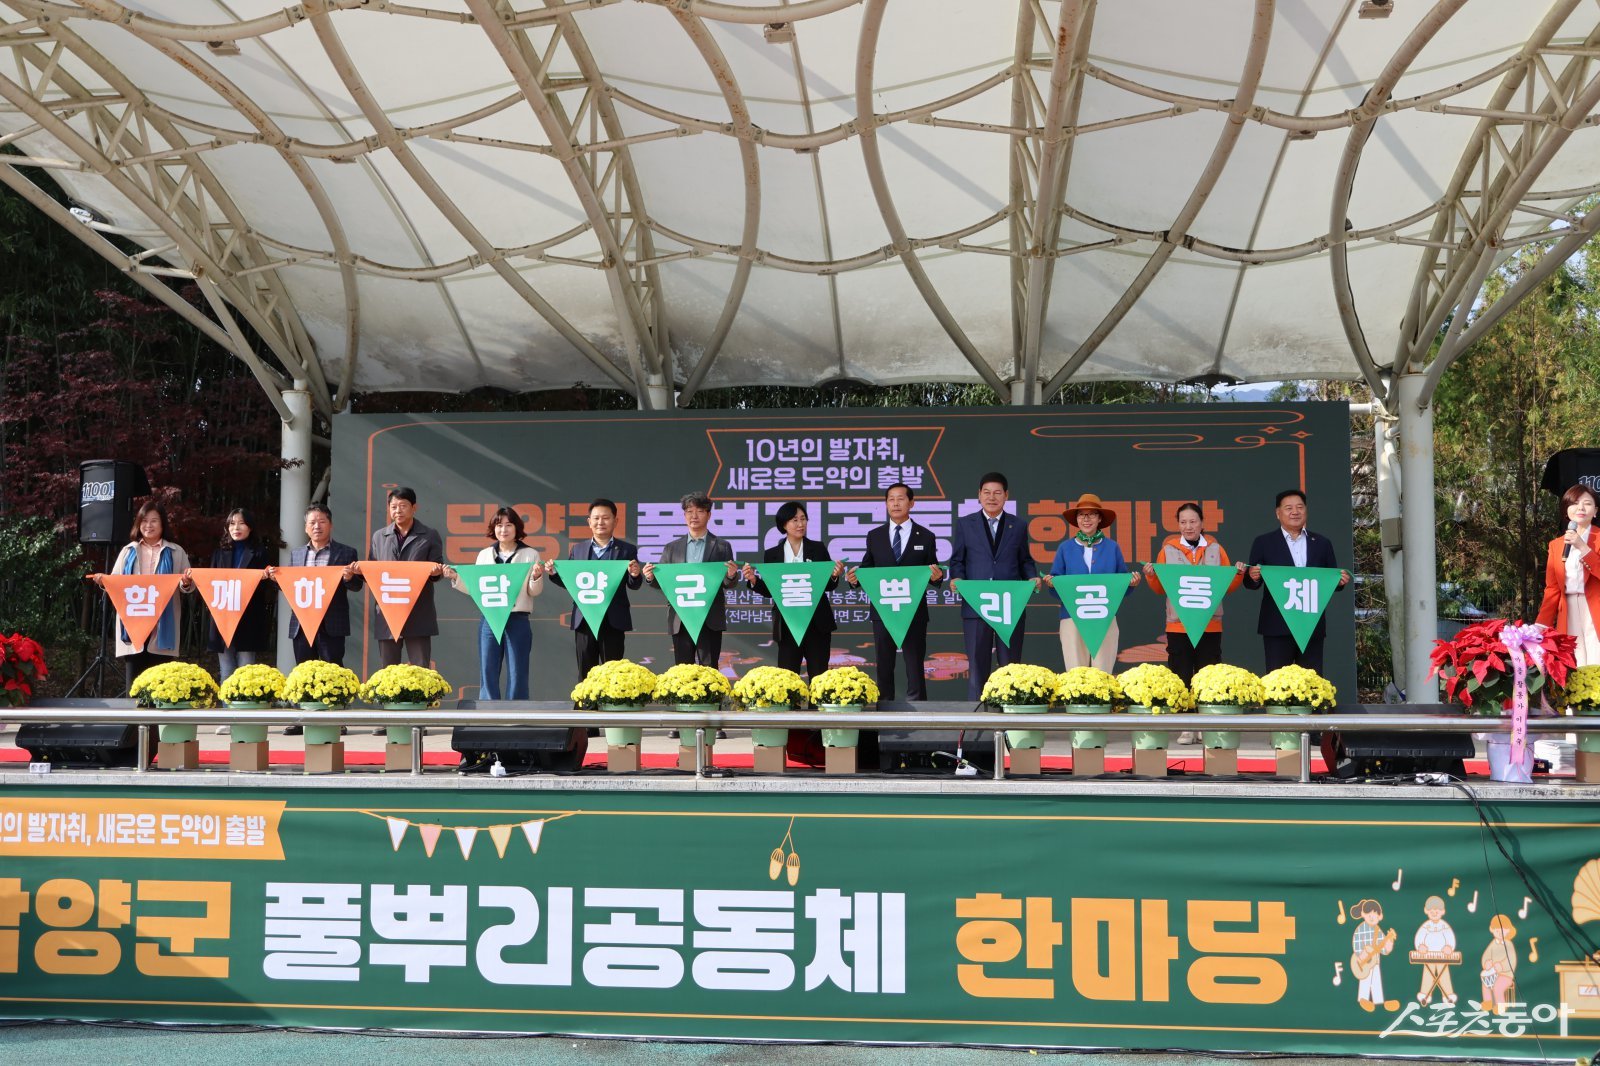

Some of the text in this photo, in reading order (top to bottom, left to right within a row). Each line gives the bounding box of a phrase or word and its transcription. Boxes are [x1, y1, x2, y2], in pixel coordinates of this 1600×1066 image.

[745, 437, 905, 463] 10년의 발자취,
[727, 465, 925, 490] 새로운 도약의 출발
[124, 585, 160, 617] 함
[211, 579, 241, 612] 께
[293, 576, 326, 609] 하
[380, 572, 412, 604] 는
[479, 575, 511, 608] 담
[575, 571, 609, 605] 양
[674, 574, 707, 607] 군
[780, 573, 814, 607] 풀
[879, 577, 912, 612] 뿌
[980, 591, 1012, 625] 리
[1076, 585, 1109, 620] 공
[1178, 575, 1213, 609] 동
[1283, 578, 1319, 614] 체
[0, 812, 266, 847] 의 발자취, 새로운 도약의 출발
[262, 881, 907, 995] 풀뿌리공동체
[955, 892, 1297, 1006] 한마당
